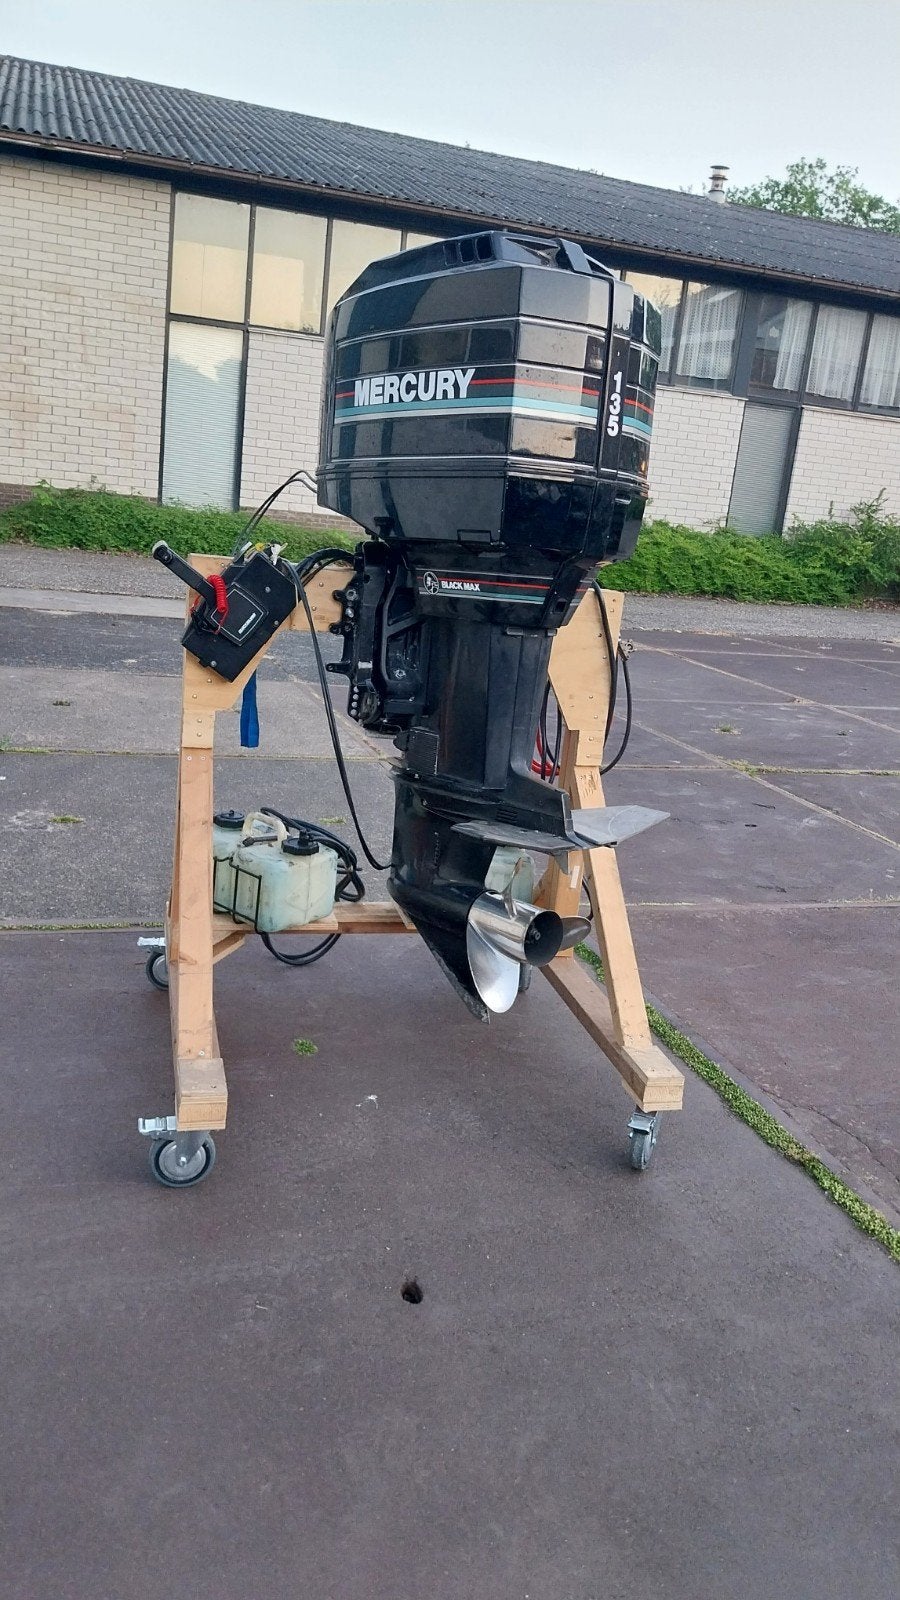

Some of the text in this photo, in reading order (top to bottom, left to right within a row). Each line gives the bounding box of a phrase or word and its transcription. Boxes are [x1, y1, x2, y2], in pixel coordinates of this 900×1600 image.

[354, 368, 476, 407] MERCURY
[606, 371, 623, 437] 135
[441, 580, 480, 592] BLACK MAX
